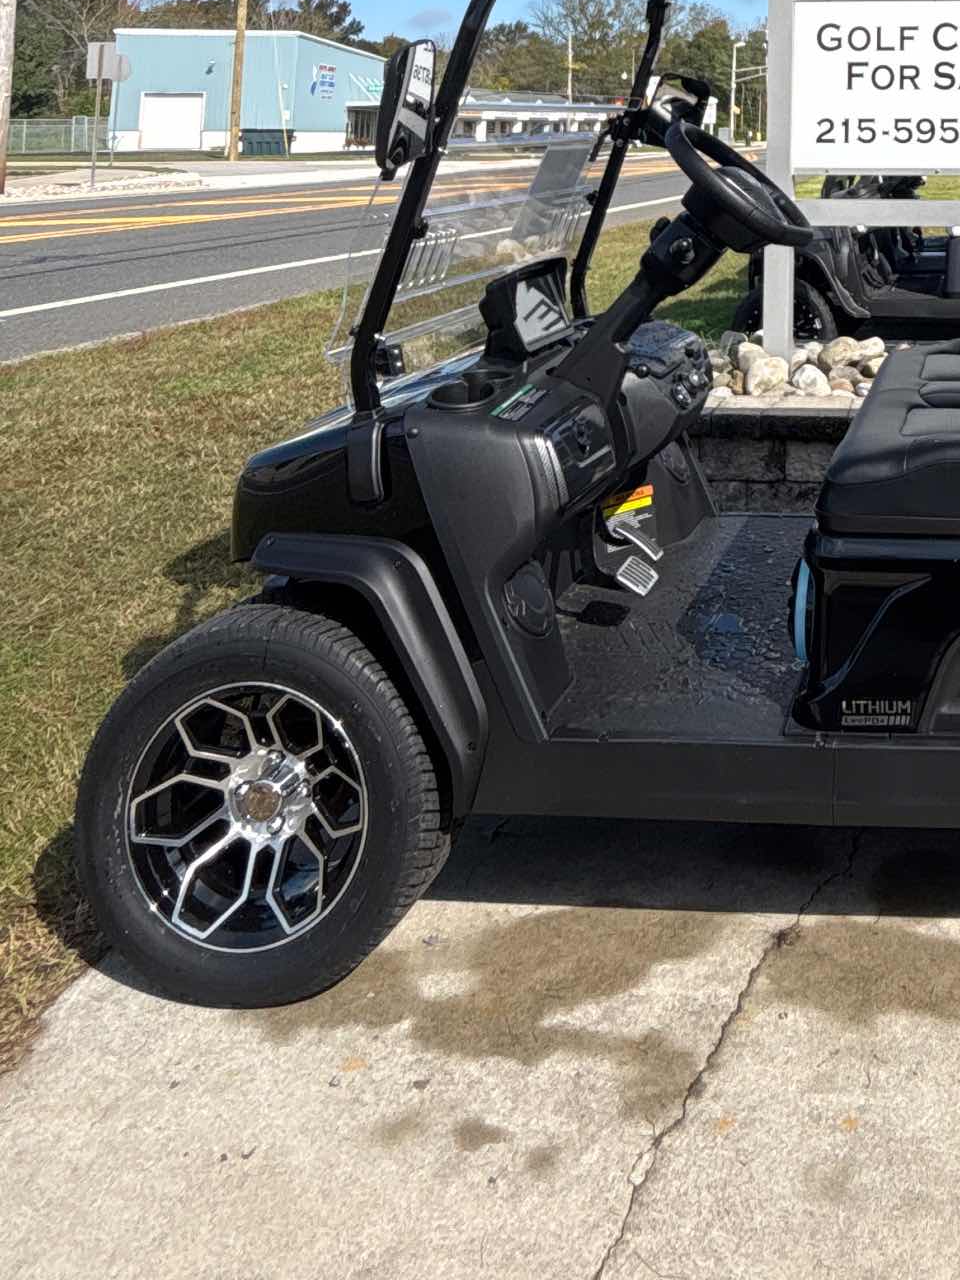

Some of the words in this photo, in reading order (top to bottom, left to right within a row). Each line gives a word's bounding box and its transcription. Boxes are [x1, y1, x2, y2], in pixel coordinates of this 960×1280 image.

[816, 23, 919, 52] GOLF
[846, 61, 920, 90] FOR
[842, 700, 911, 714] LITHIUM
